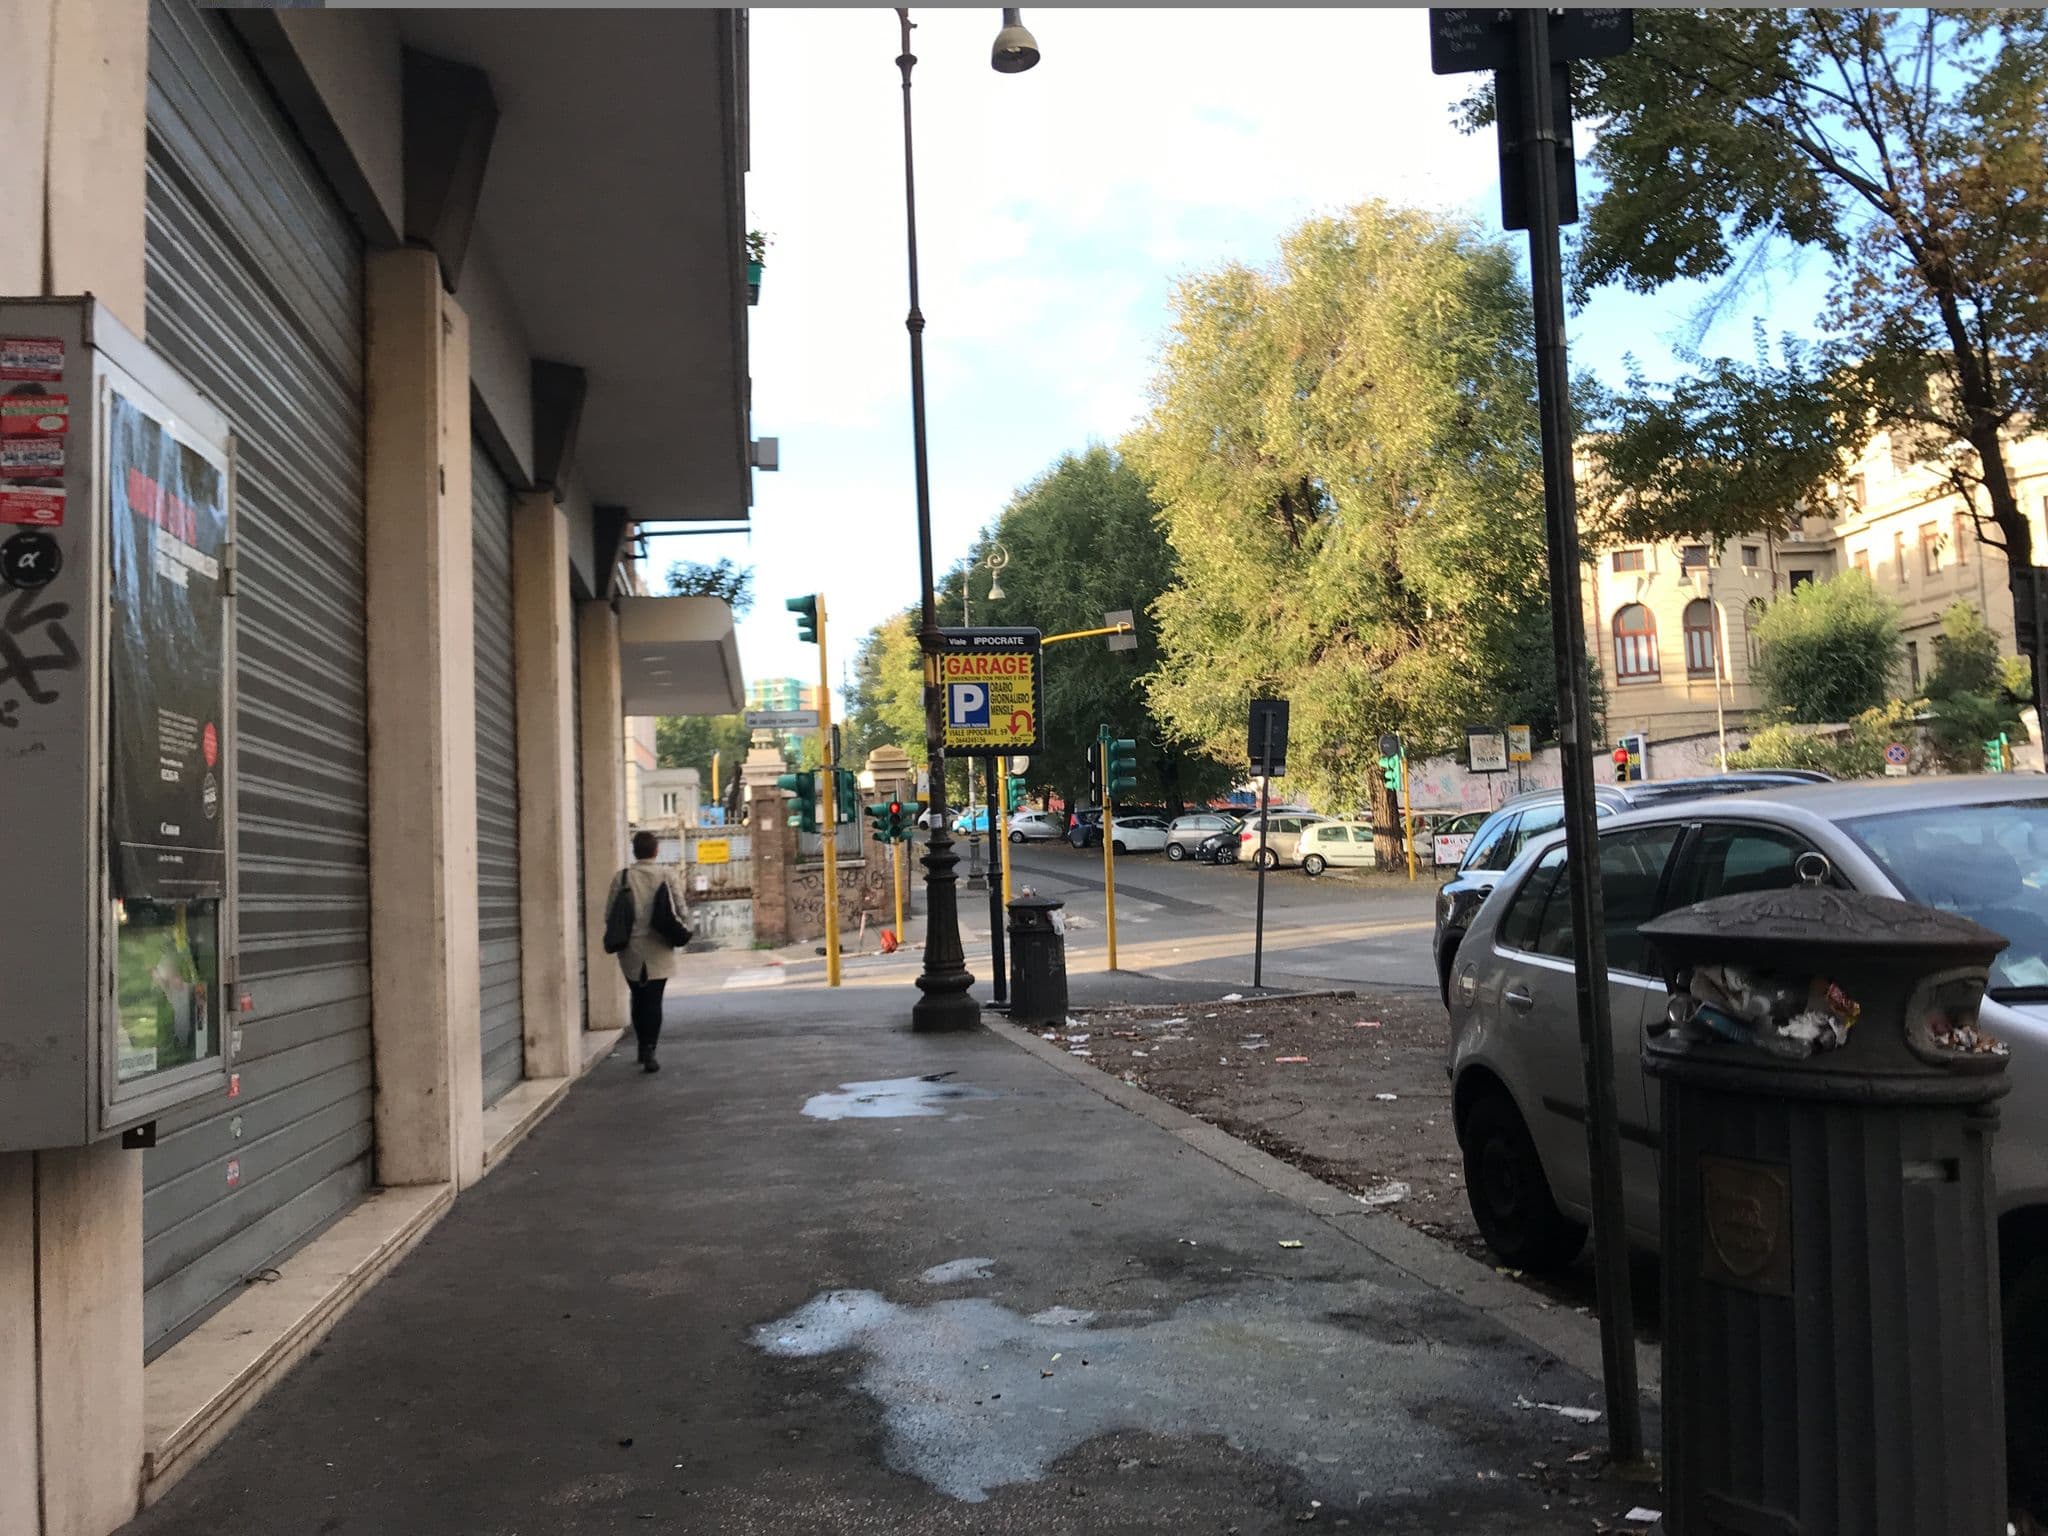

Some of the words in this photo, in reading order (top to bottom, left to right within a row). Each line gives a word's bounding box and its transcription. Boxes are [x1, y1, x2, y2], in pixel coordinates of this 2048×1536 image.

[974, 637, 1024, 645] IPPOCRATE
[947, 657, 1028, 674] GARAGE
[990, 682, 1013, 692] ORARIO
[953, 684, 984, 723] P
[991, 705, 1014, 715] MENSILE
